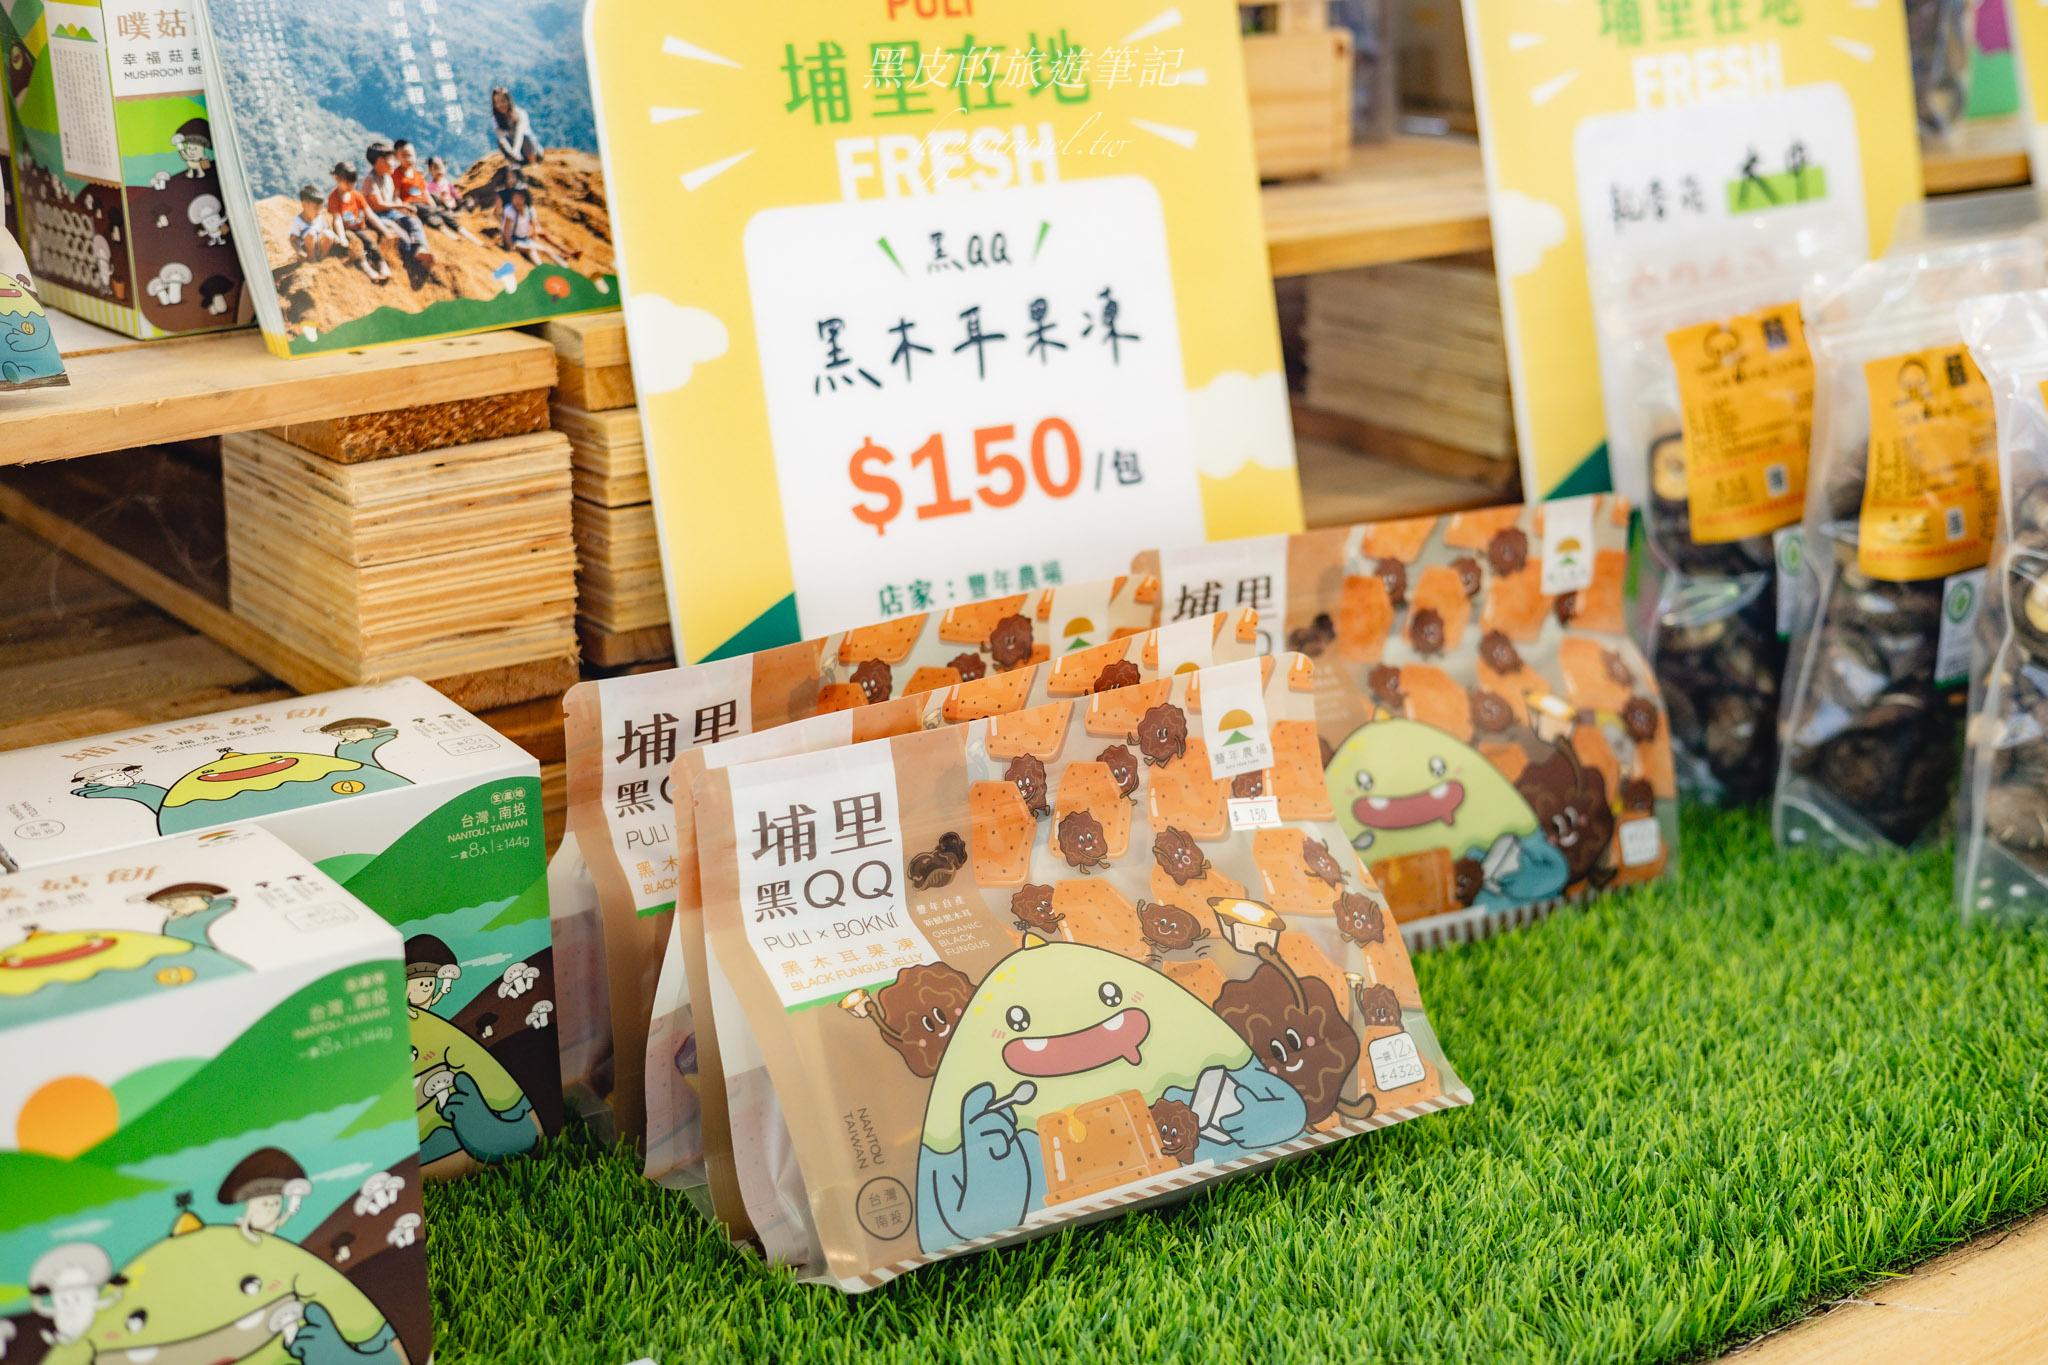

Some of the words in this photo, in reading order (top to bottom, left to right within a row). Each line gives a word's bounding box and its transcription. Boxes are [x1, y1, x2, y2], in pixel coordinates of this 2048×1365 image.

[124, 67, 184, 80] MUSHROOM
[780, 29, 1092, 125] 埔里在地
[1632, 40, 1786, 108] FRESH
[836, 122, 1060, 201] FRESH
[814, 287, 1140, 394] 黑木耳果凍
[848, 415, 1082, 537] $150
[616, 699, 739, 769] 埔里
[616, 776, 673, 818] 黑
[626, 824, 670, 850] PULI
[752, 792, 893, 867] 埔里
[644, 876, 679, 896] BLACK
[755, 860, 894, 923] 黑QQ
[763, 928, 813, 952] PULI
[932, 921, 983, 938] ORGANIC
[938, 932, 976, 948] BLACK
[945, 939, 990, 956] FUNGUS
[790, 973, 836, 992] BLACK
[836, 960, 889, 981] FUNGUS
[889, 953, 925, 971] JELLY
[843, 1112, 869, 1170] TAIWAN
[857, 1107, 885, 1165] NANTOU
